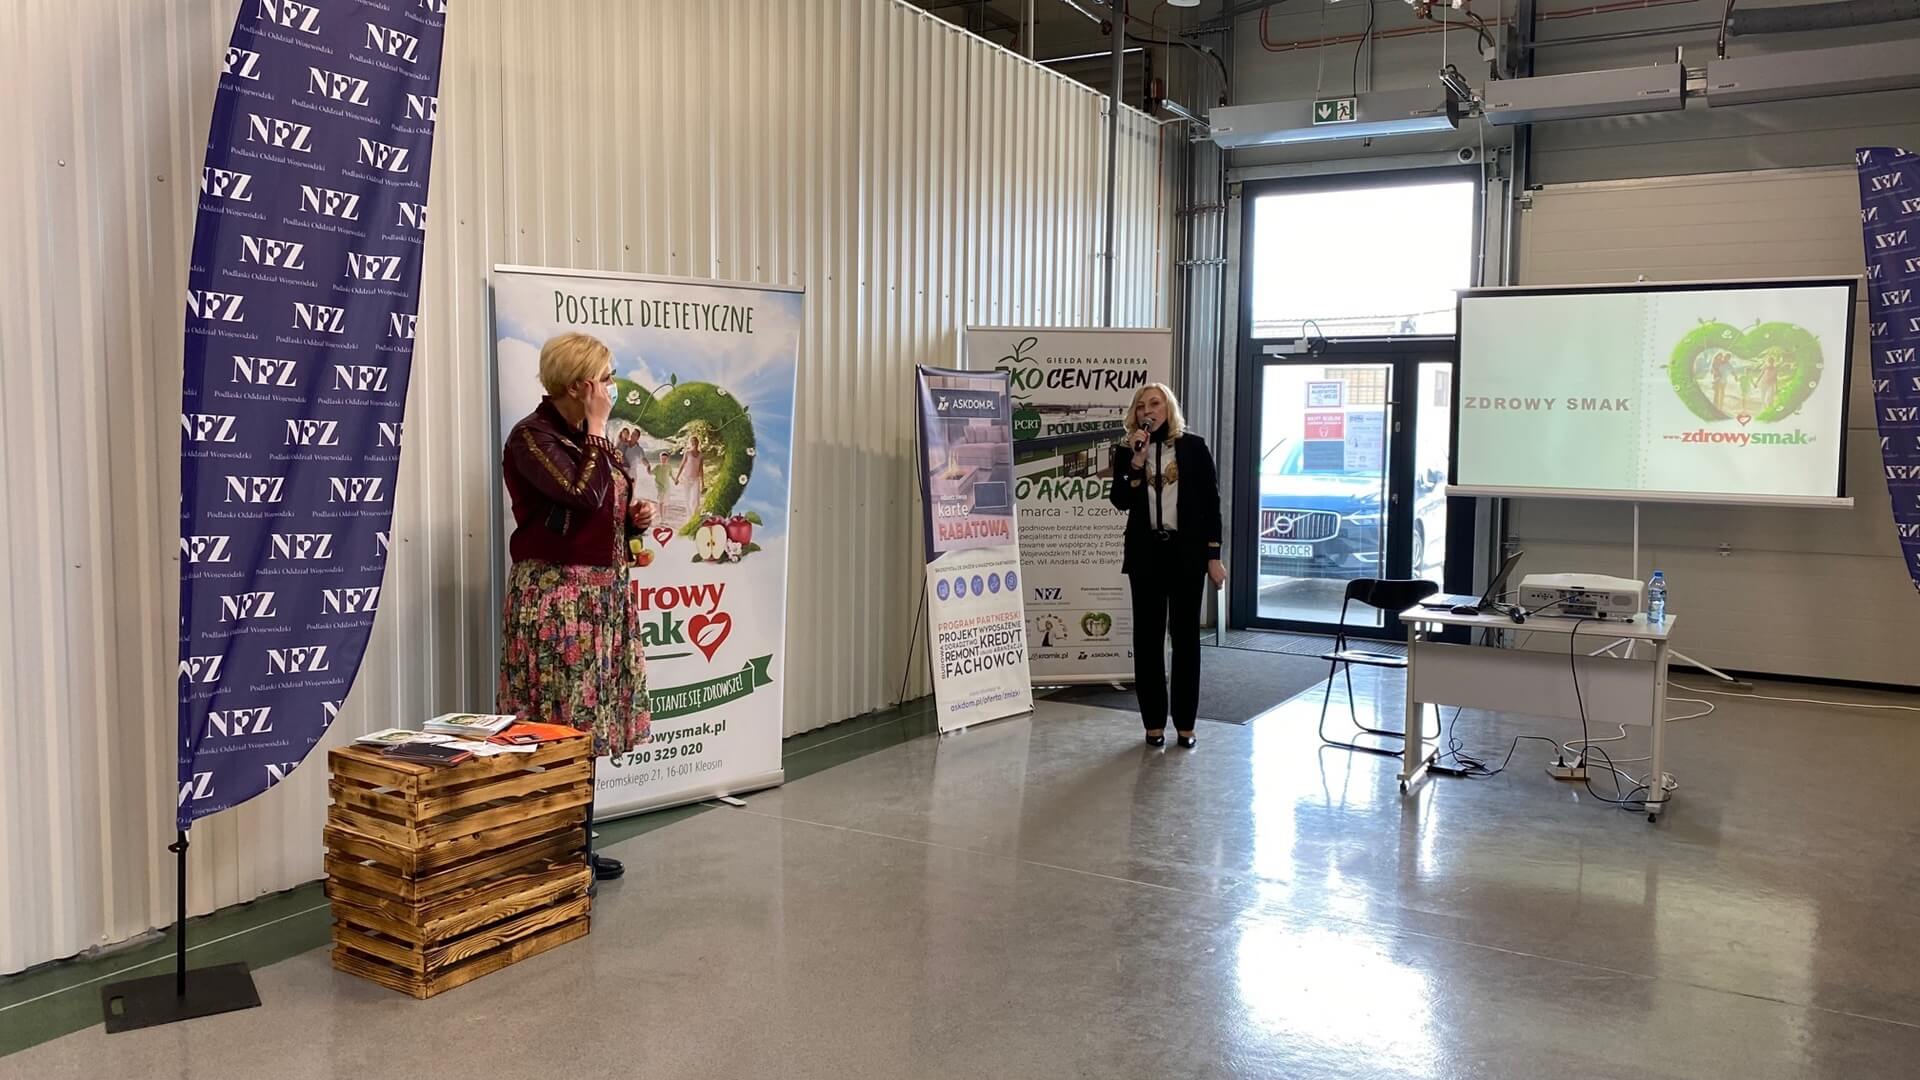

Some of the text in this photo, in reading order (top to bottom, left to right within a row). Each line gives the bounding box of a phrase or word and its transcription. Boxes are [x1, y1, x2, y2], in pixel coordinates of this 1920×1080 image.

[256, 0, 321, 35] NFZ
[365, 22, 418, 63] NFZ
[224, 47, 261, 81] FZ
[307, 67, 369, 107] NFZ
[246, 113, 312, 153] NFZ
[357, 137, 409, 173] NFZ
[299, 184, 360, 221] NFZ
[239, 235, 305, 270] NFZ
[344, 252, 401, 281] NFZ
[292, 302, 345, 334] NFZ
[640, 299, 755, 334] DIETETYCZNE
[231, 355, 297, 387] NFZ
[1046, 357, 1082, 365] GIEŁDA
[333, 365, 388, 392] NFZ
[995, 366, 1148, 393] KO CENTRUM
[1464, 397, 1630, 412] ZDROWY SMAK
[284, 419, 339, 446] NFZ
[1014, 418, 1042, 430] PCRT
[224, 475, 285, 503] NFZ
[328, 477, 384, 503] NFZ
[1036, 478, 1113, 503] AKADE
[1020, 508, 1061, 517] marca
[1072, 506, 1084, 517] 12
[938, 519, 1010, 541] RABATOWĄ
[268, 533, 333, 560] NFZ
[219, 591, 277, 622] NFZ
[320, 586, 380, 615] NFZ
[1034, 588, 1062, 600] NFZ
[641, 611, 686, 647] ak
[938, 617, 975, 632] PROGRAM
[938, 627, 978, 644] PROJEKT
[980, 629, 1022, 649] KREDYT
[265, 645, 330, 675] NFZ
[945, 646, 980, 662] REMONT
[946, 649, 1024, 678] FACHOWCY
[656, 691, 688, 713] STANIE
[702, 674, 744, 702] ZDROWSZE!
[206, 706, 274, 739] NFZ
[627, 742, 703, 767] 790 329 020
[667, 763, 693, 778] 16-001
[695, 758, 723, 773] Kleosin
